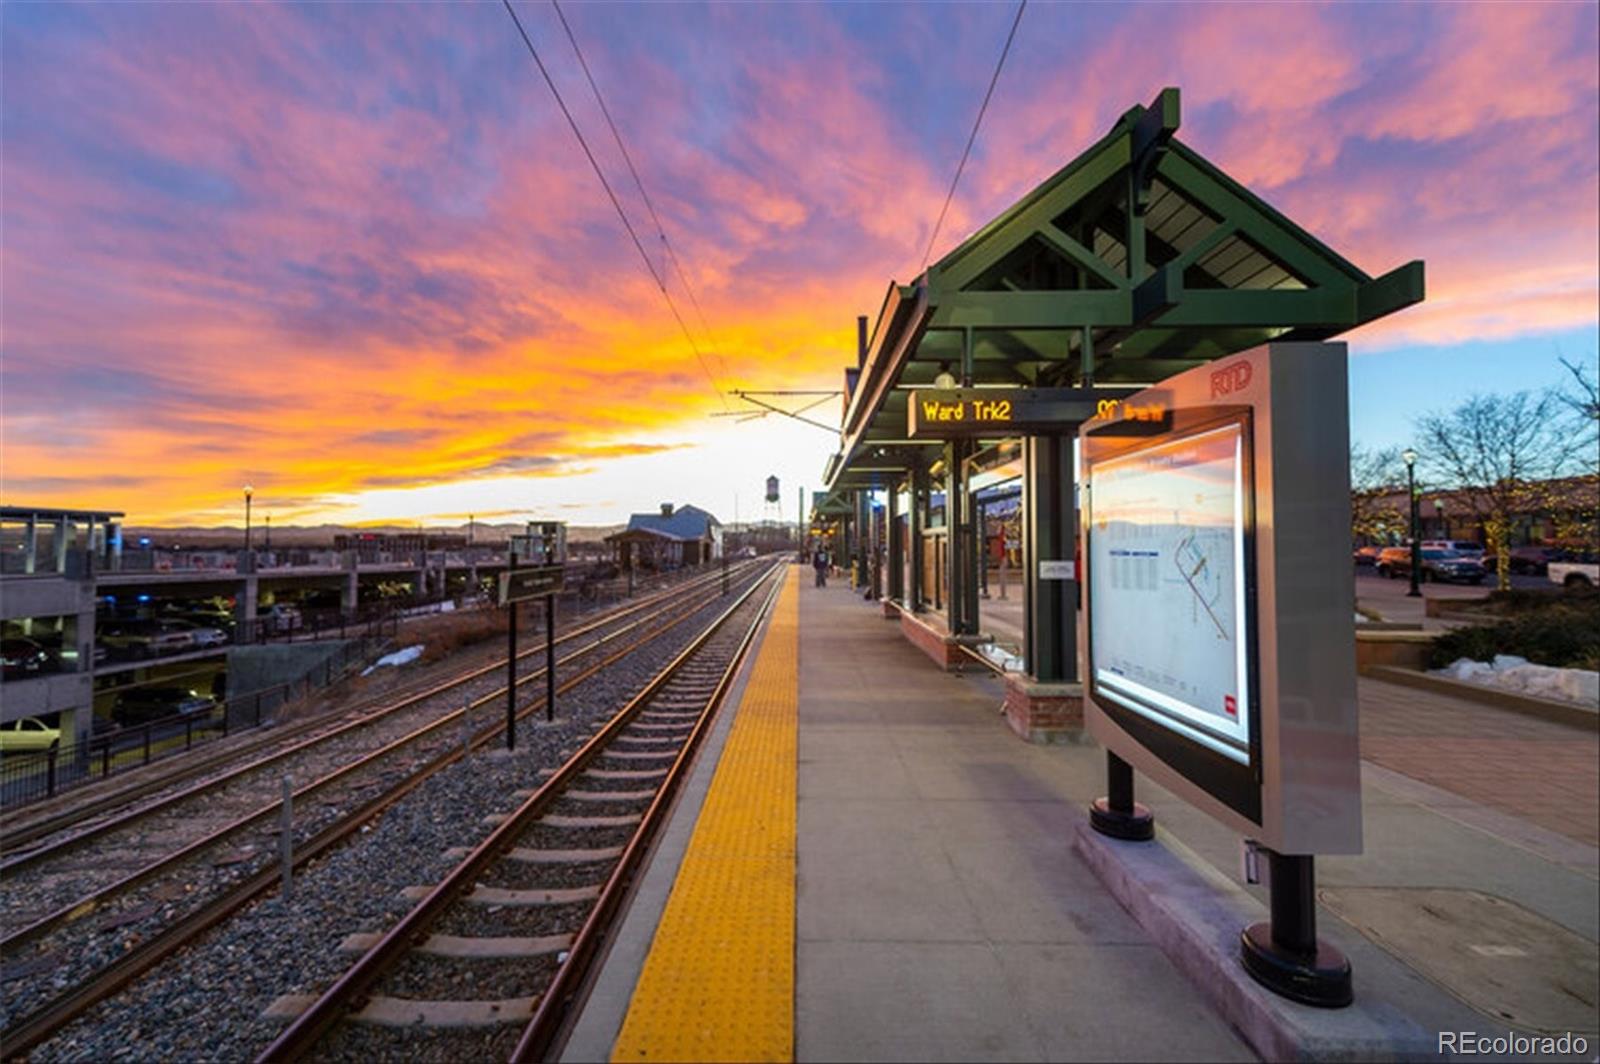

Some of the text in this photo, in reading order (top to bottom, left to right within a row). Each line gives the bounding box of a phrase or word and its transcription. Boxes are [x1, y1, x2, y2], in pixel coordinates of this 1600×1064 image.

[1211, 360, 1252, 400] RTD
[923, 400, 1011, 420] Ward Trk2
